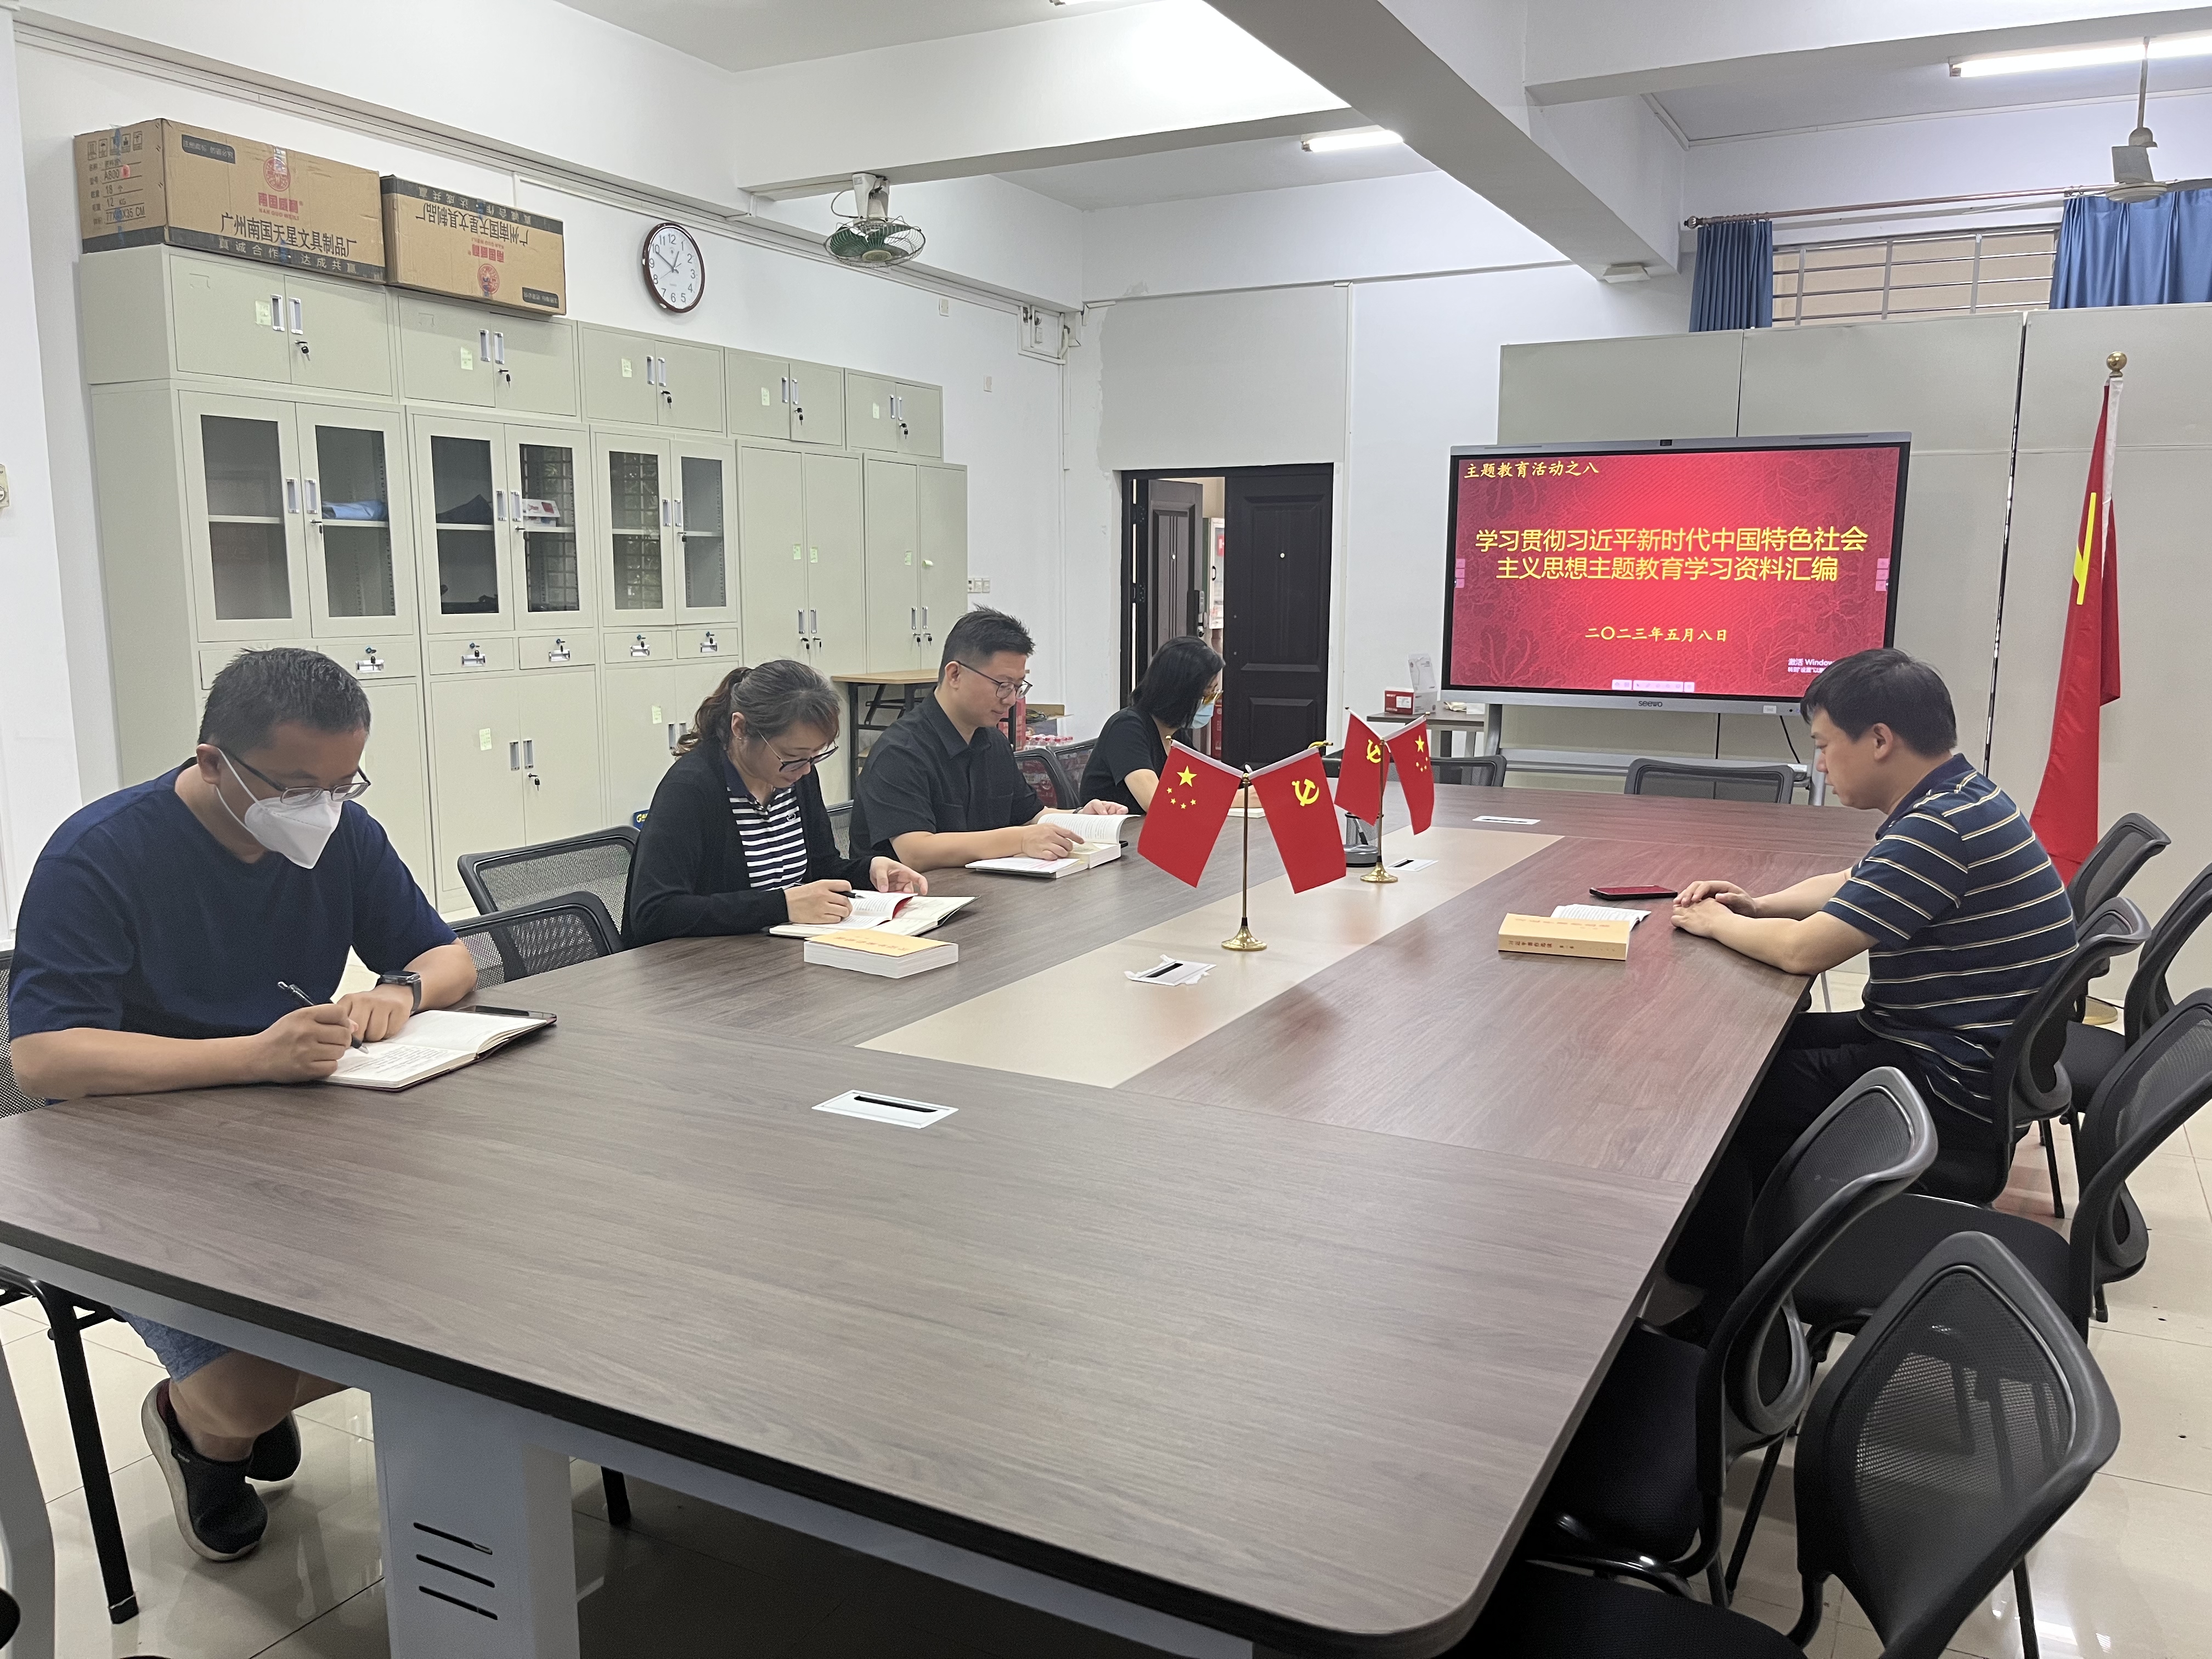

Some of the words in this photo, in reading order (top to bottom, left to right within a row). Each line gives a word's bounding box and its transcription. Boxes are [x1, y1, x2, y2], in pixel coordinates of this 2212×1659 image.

[415, 202, 529, 246] 广州南国天星文具制品厂
[221, 212, 357, 258] 广州南国天星文具制品厂
[659, 235, 665, 245] 11
[668, 234, 676, 245] 12
[218, 237, 279, 258] 真诚合作
[652, 244, 660, 253] 10
[681, 241, 684, 251] 1
[649, 258, 654, 268] 9
[687, 253, 692, 263] 2
[653, 274, 658, 284] 8
[690, 269, 696, 279] 3
[661, 287, 667, 297] 7
[688, 283, 693, 293] 4
[670, 292, 676, 302] 6
[681, 293, 686, 302] 5
[1464, 461, 1599, 478] 主题教育活动之八
[1475, 526, 1868, 552] 学习贯彻习近平新时代中国特色社会
[1496, 556, 1838, 582] 主义思想主题教育学习资料汇编
